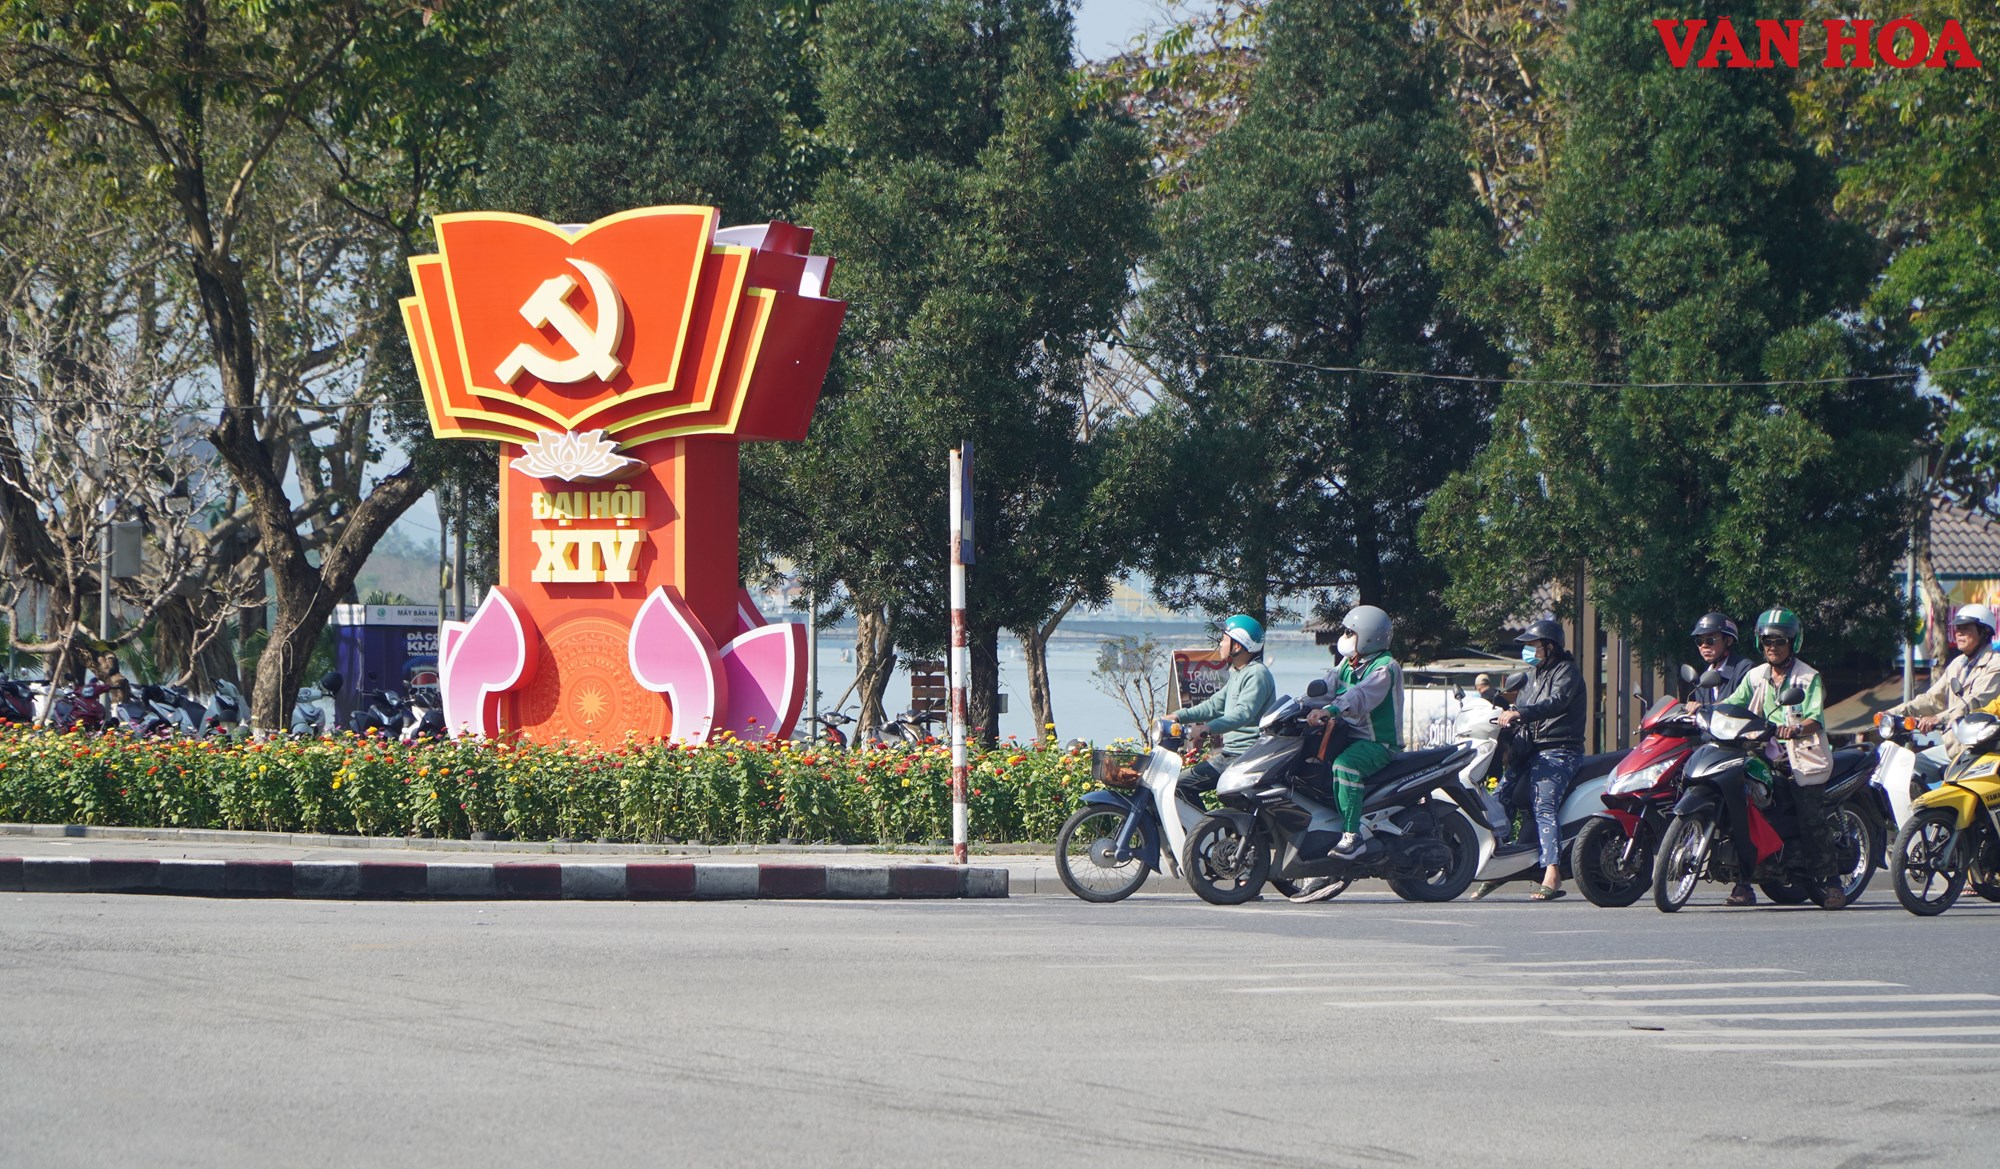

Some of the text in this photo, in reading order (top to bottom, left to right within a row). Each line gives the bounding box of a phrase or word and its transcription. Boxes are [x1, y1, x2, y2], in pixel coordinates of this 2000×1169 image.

[531, 484, 646, 527] ĐẠI HỘI
[531, 529, 647, 583] XIV
[1262, 796, 1283, 804] HONDA
